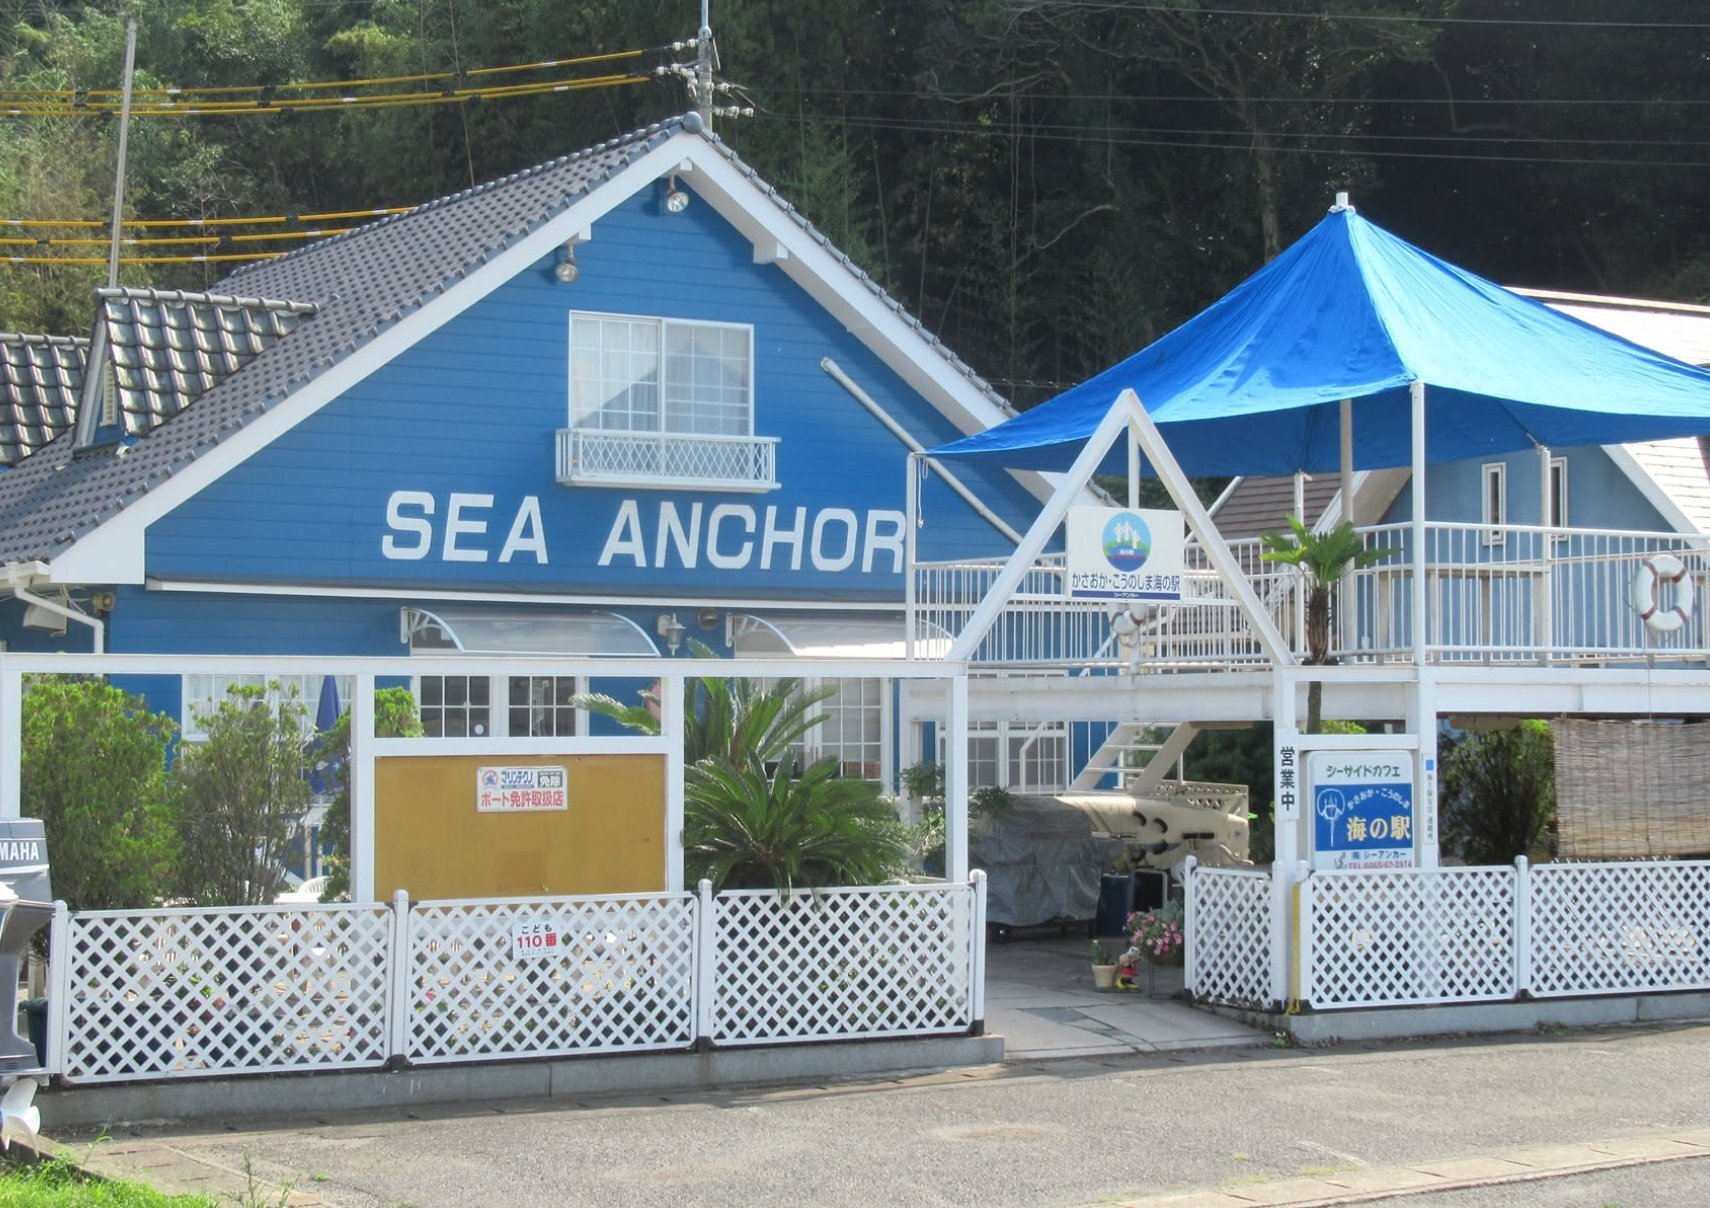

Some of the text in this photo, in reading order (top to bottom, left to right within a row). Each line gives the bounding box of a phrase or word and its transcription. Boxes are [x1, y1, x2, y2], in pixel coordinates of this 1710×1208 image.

[382, 490, 906, 574] SEA ANCHOR
[1280, 746, 1295, 811] 営業中
[1326, 765, 1401, 778] シーサイドカフェ
[481, 790, 564, 807] ボート免許取扱店
[1346, 815, 1411, 841] 海の駅
[0, 841, 40, 861] MAHA
[521, 923, 552, 934] こども
